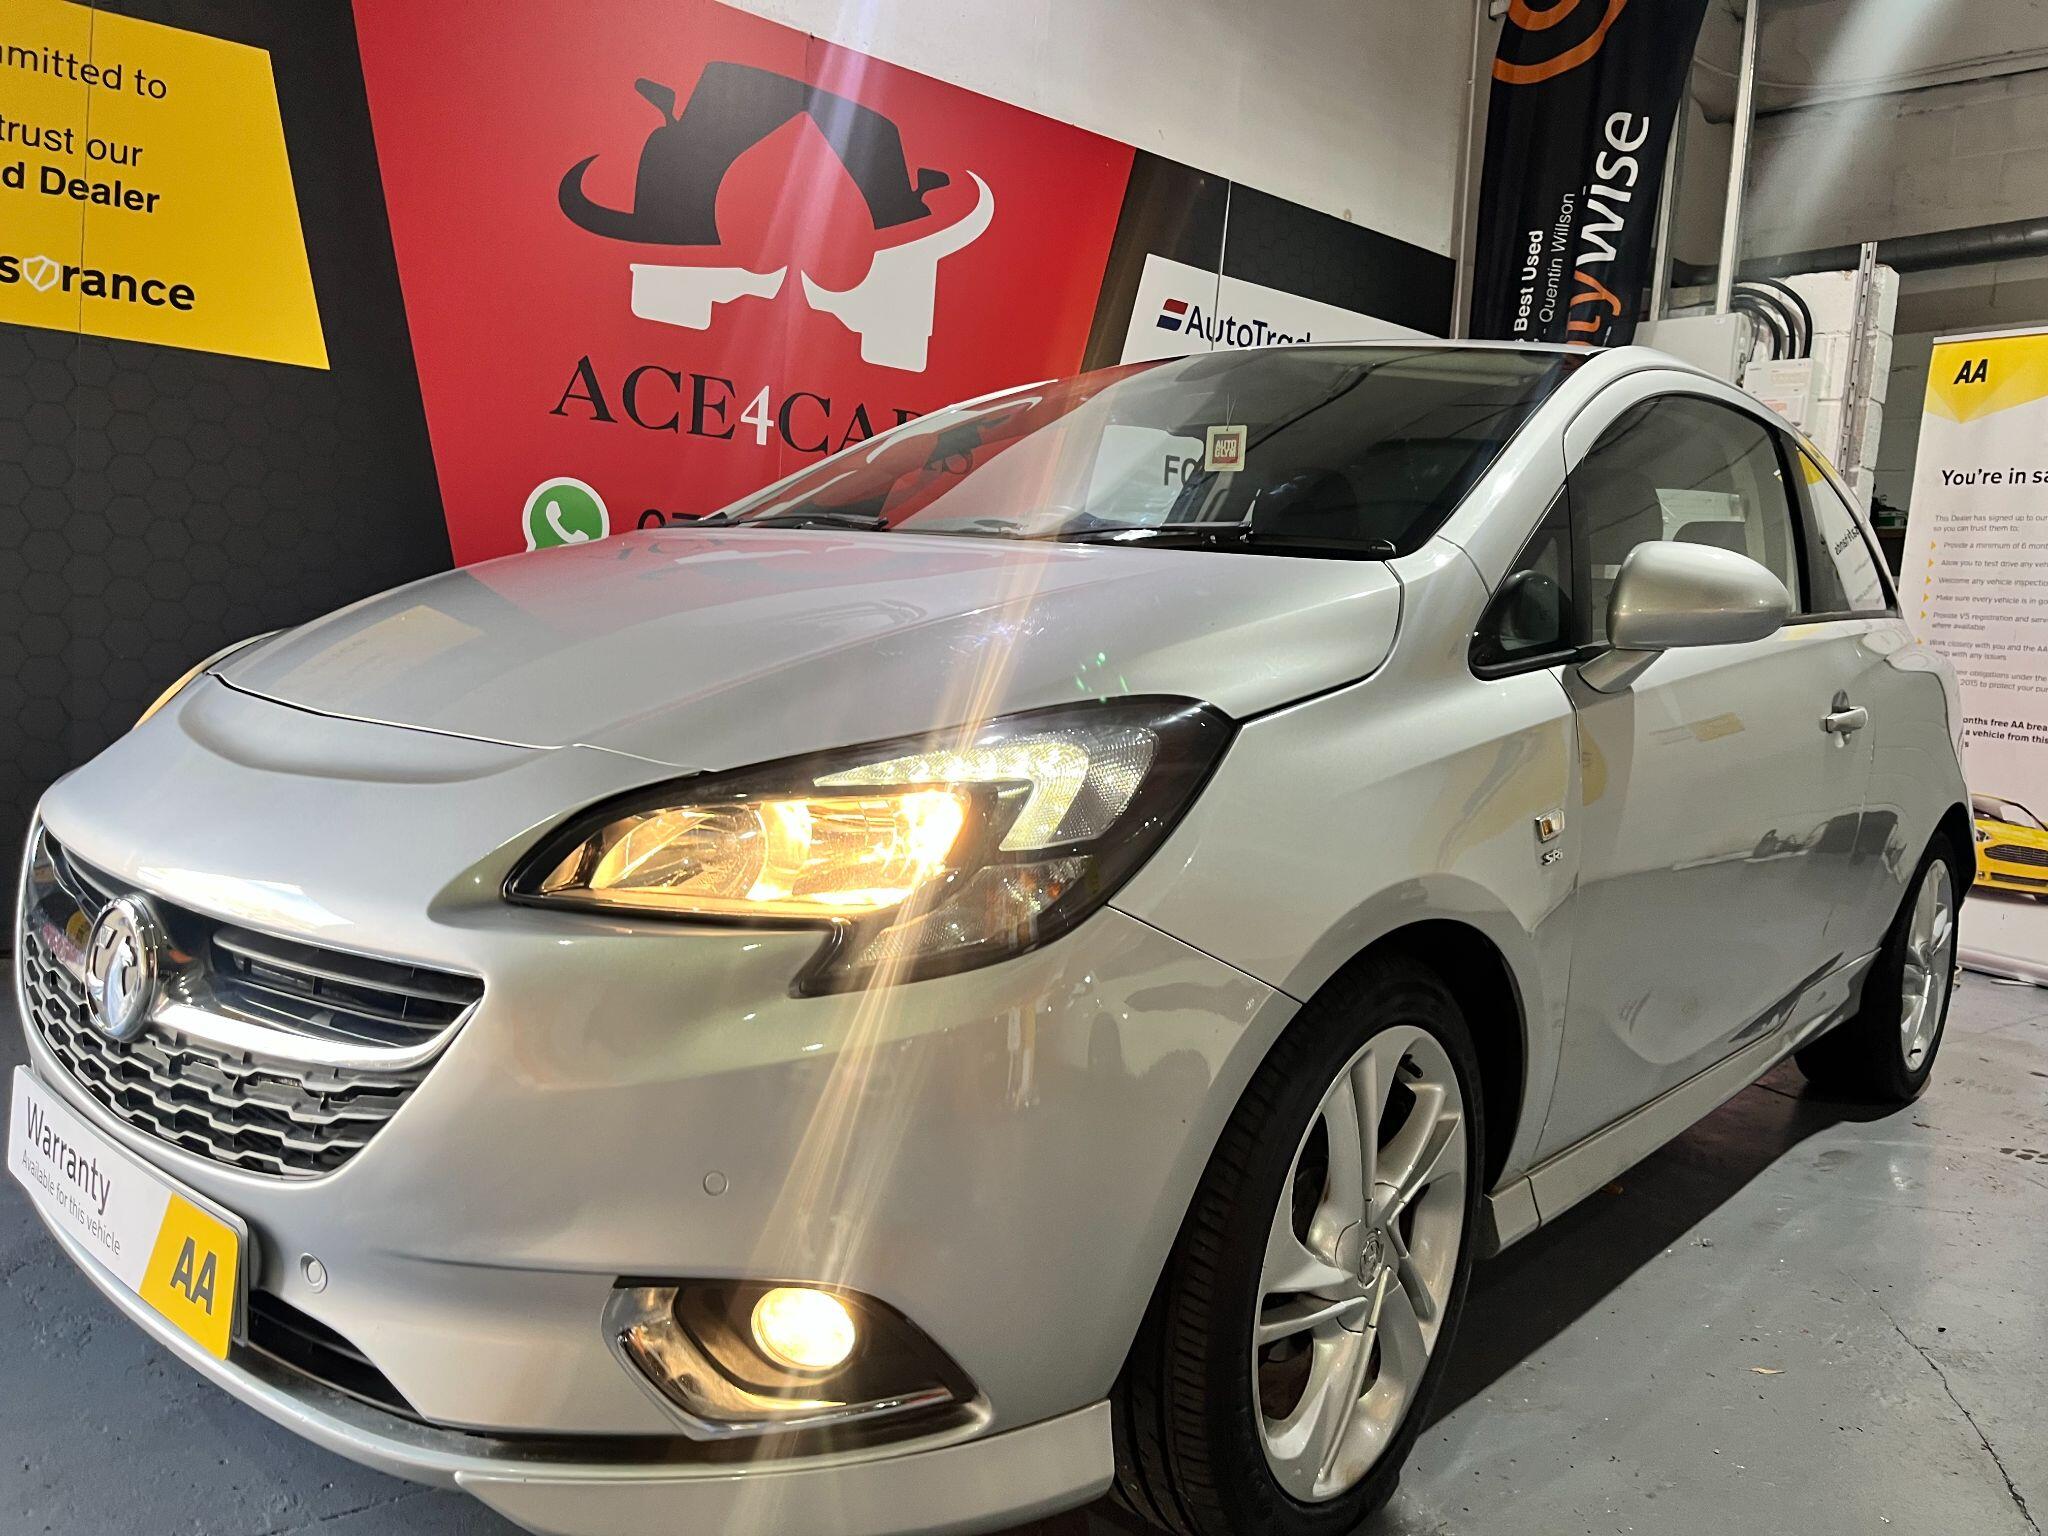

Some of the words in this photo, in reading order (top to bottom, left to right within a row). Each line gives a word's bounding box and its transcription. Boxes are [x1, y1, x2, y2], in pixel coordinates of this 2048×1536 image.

[0, 45, 122, 90] mitted
[134, 69, 167, 99] to
[0, 114, 74, 155] trust
[86, 138, 144, 167] our
[40, 165, 160, 213] Dealer
[1521, 230, 1544, 281] Used
[1539, 258, 1563, 323] Quentin
[1551, 193, 1575, 252] Willson
[1514, 286, 1535, 332] Best
[1953, 359, 1988, 385] AA
[1214, 448, 1237, 458] GLYM
[1215, 440, 1237, 450] AUTO
[1941, 468, 2003, 486] You're
[2008, 467, 2026, 484] in
[1989, 514, 2013, 523] signed
[1971, 578, 1985, 586] any
[1971, 613, 2013, 622] registration
[2011, 673, 2033, 681] under
[1962, 717, 1988, 726] onths
[1990, 718, 2009, 728] free
[2010, 720, 2025, 729] AA
[1972, 729, 2005, 740] vehicle
[2007, 732, 2029, 742] from
[2031, 735, 2048, 744] this
[26, 1095, 111, 1216] Warranty
[22, 1149, 55, 1196] Available
[56, 1183, 68, 1208] for
[69, 1196, 85, 1225] this
[87, 1214, 121, 1256] vehicle
[169, 1236, 217, 1316] AA
